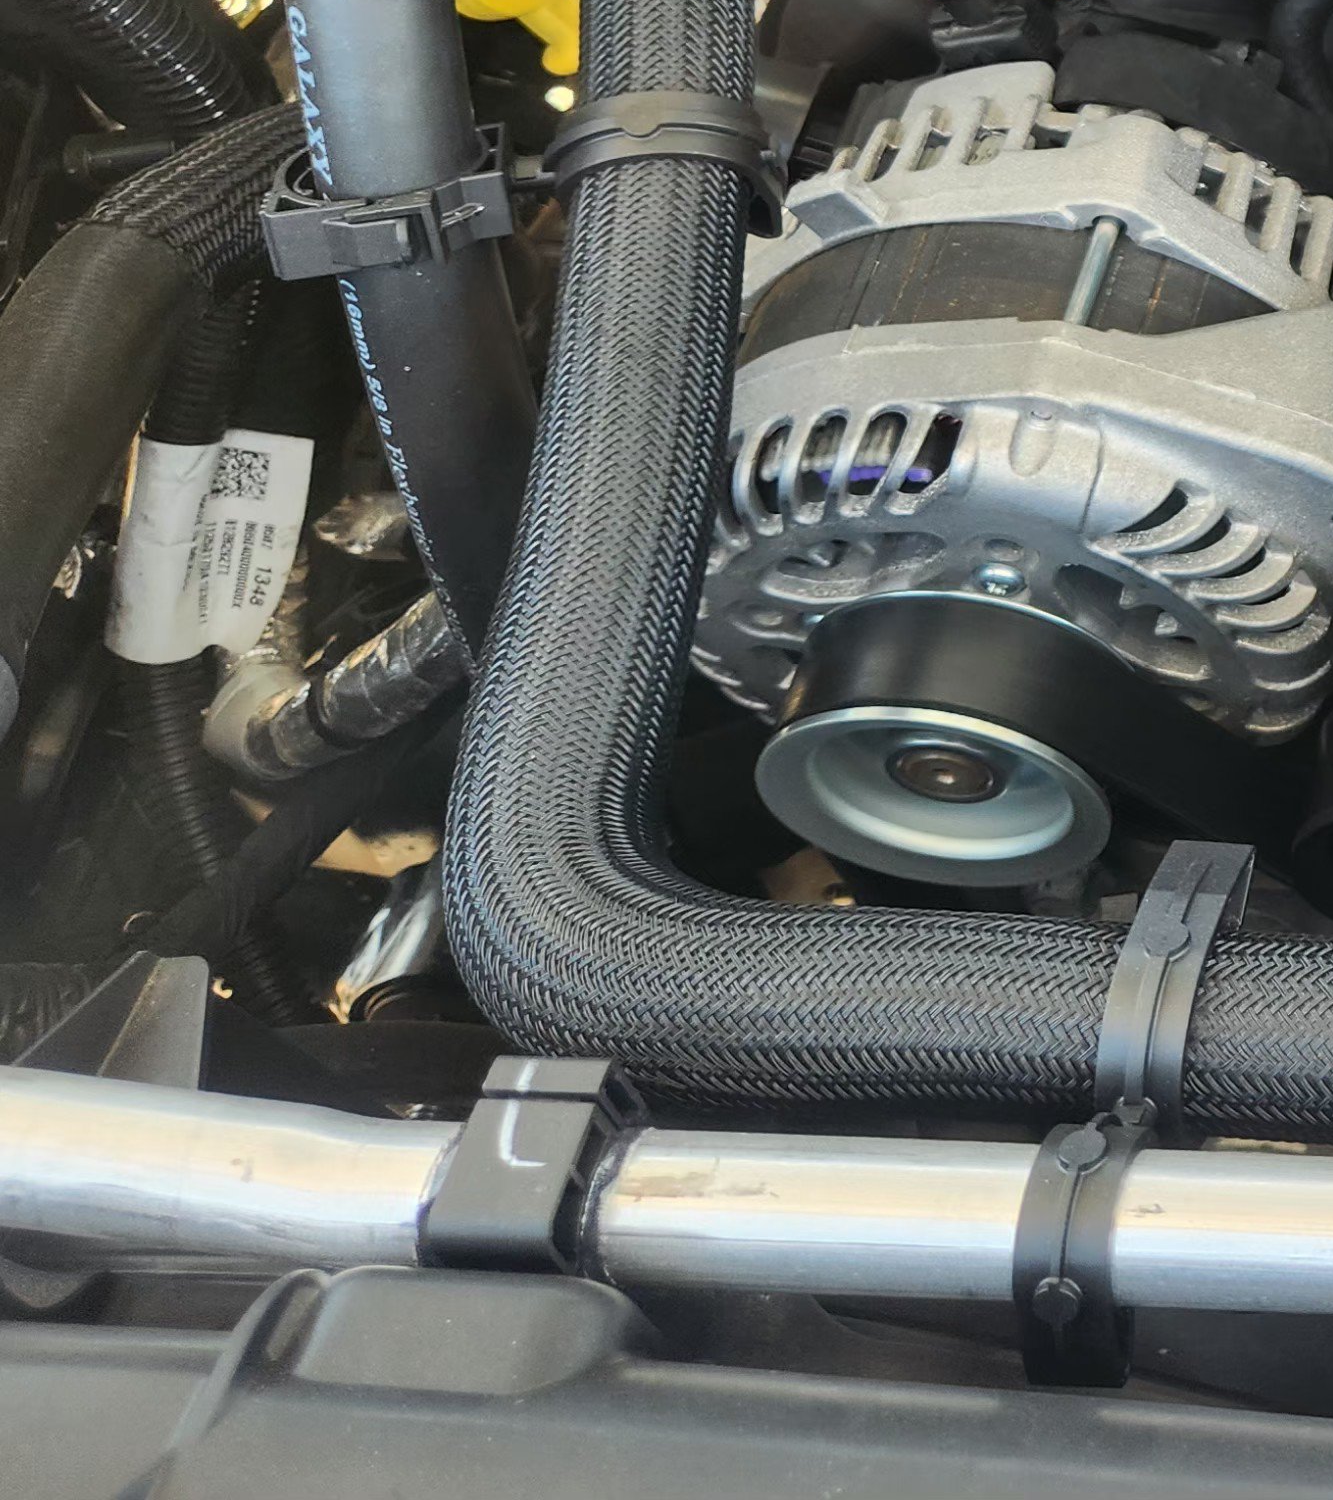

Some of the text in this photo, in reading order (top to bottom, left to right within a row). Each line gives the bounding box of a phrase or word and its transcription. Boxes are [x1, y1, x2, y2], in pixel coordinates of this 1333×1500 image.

[288, 6, 333, 185] GALAXY
[339, 279, 377, 370] (16mm)
[366, 374, 388, 412] 5/8
[249, 566, 272, 607] 1348
